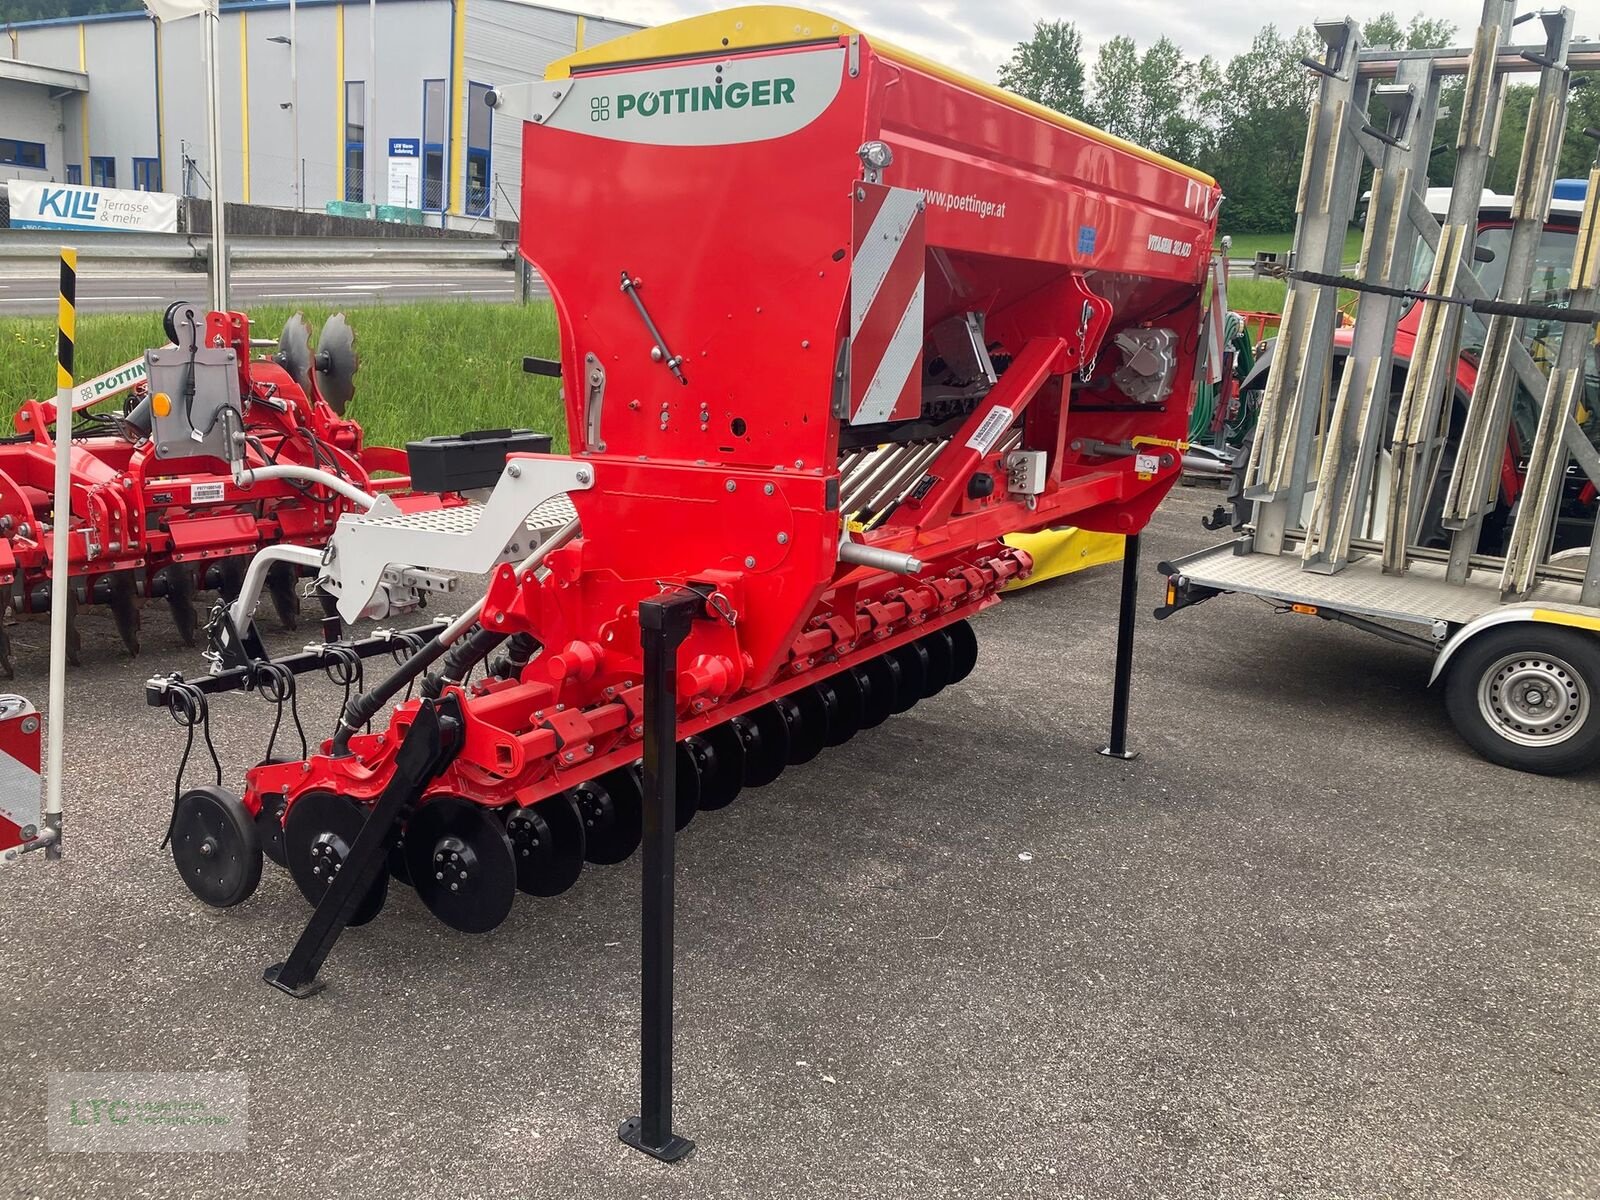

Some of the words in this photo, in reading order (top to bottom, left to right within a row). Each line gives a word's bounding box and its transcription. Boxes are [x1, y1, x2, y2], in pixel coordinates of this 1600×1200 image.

[104, 198, 149, 213] Terrasse
[100, 211, 109, 222] &
[94, 361, 146, 394] PÖTTIN
